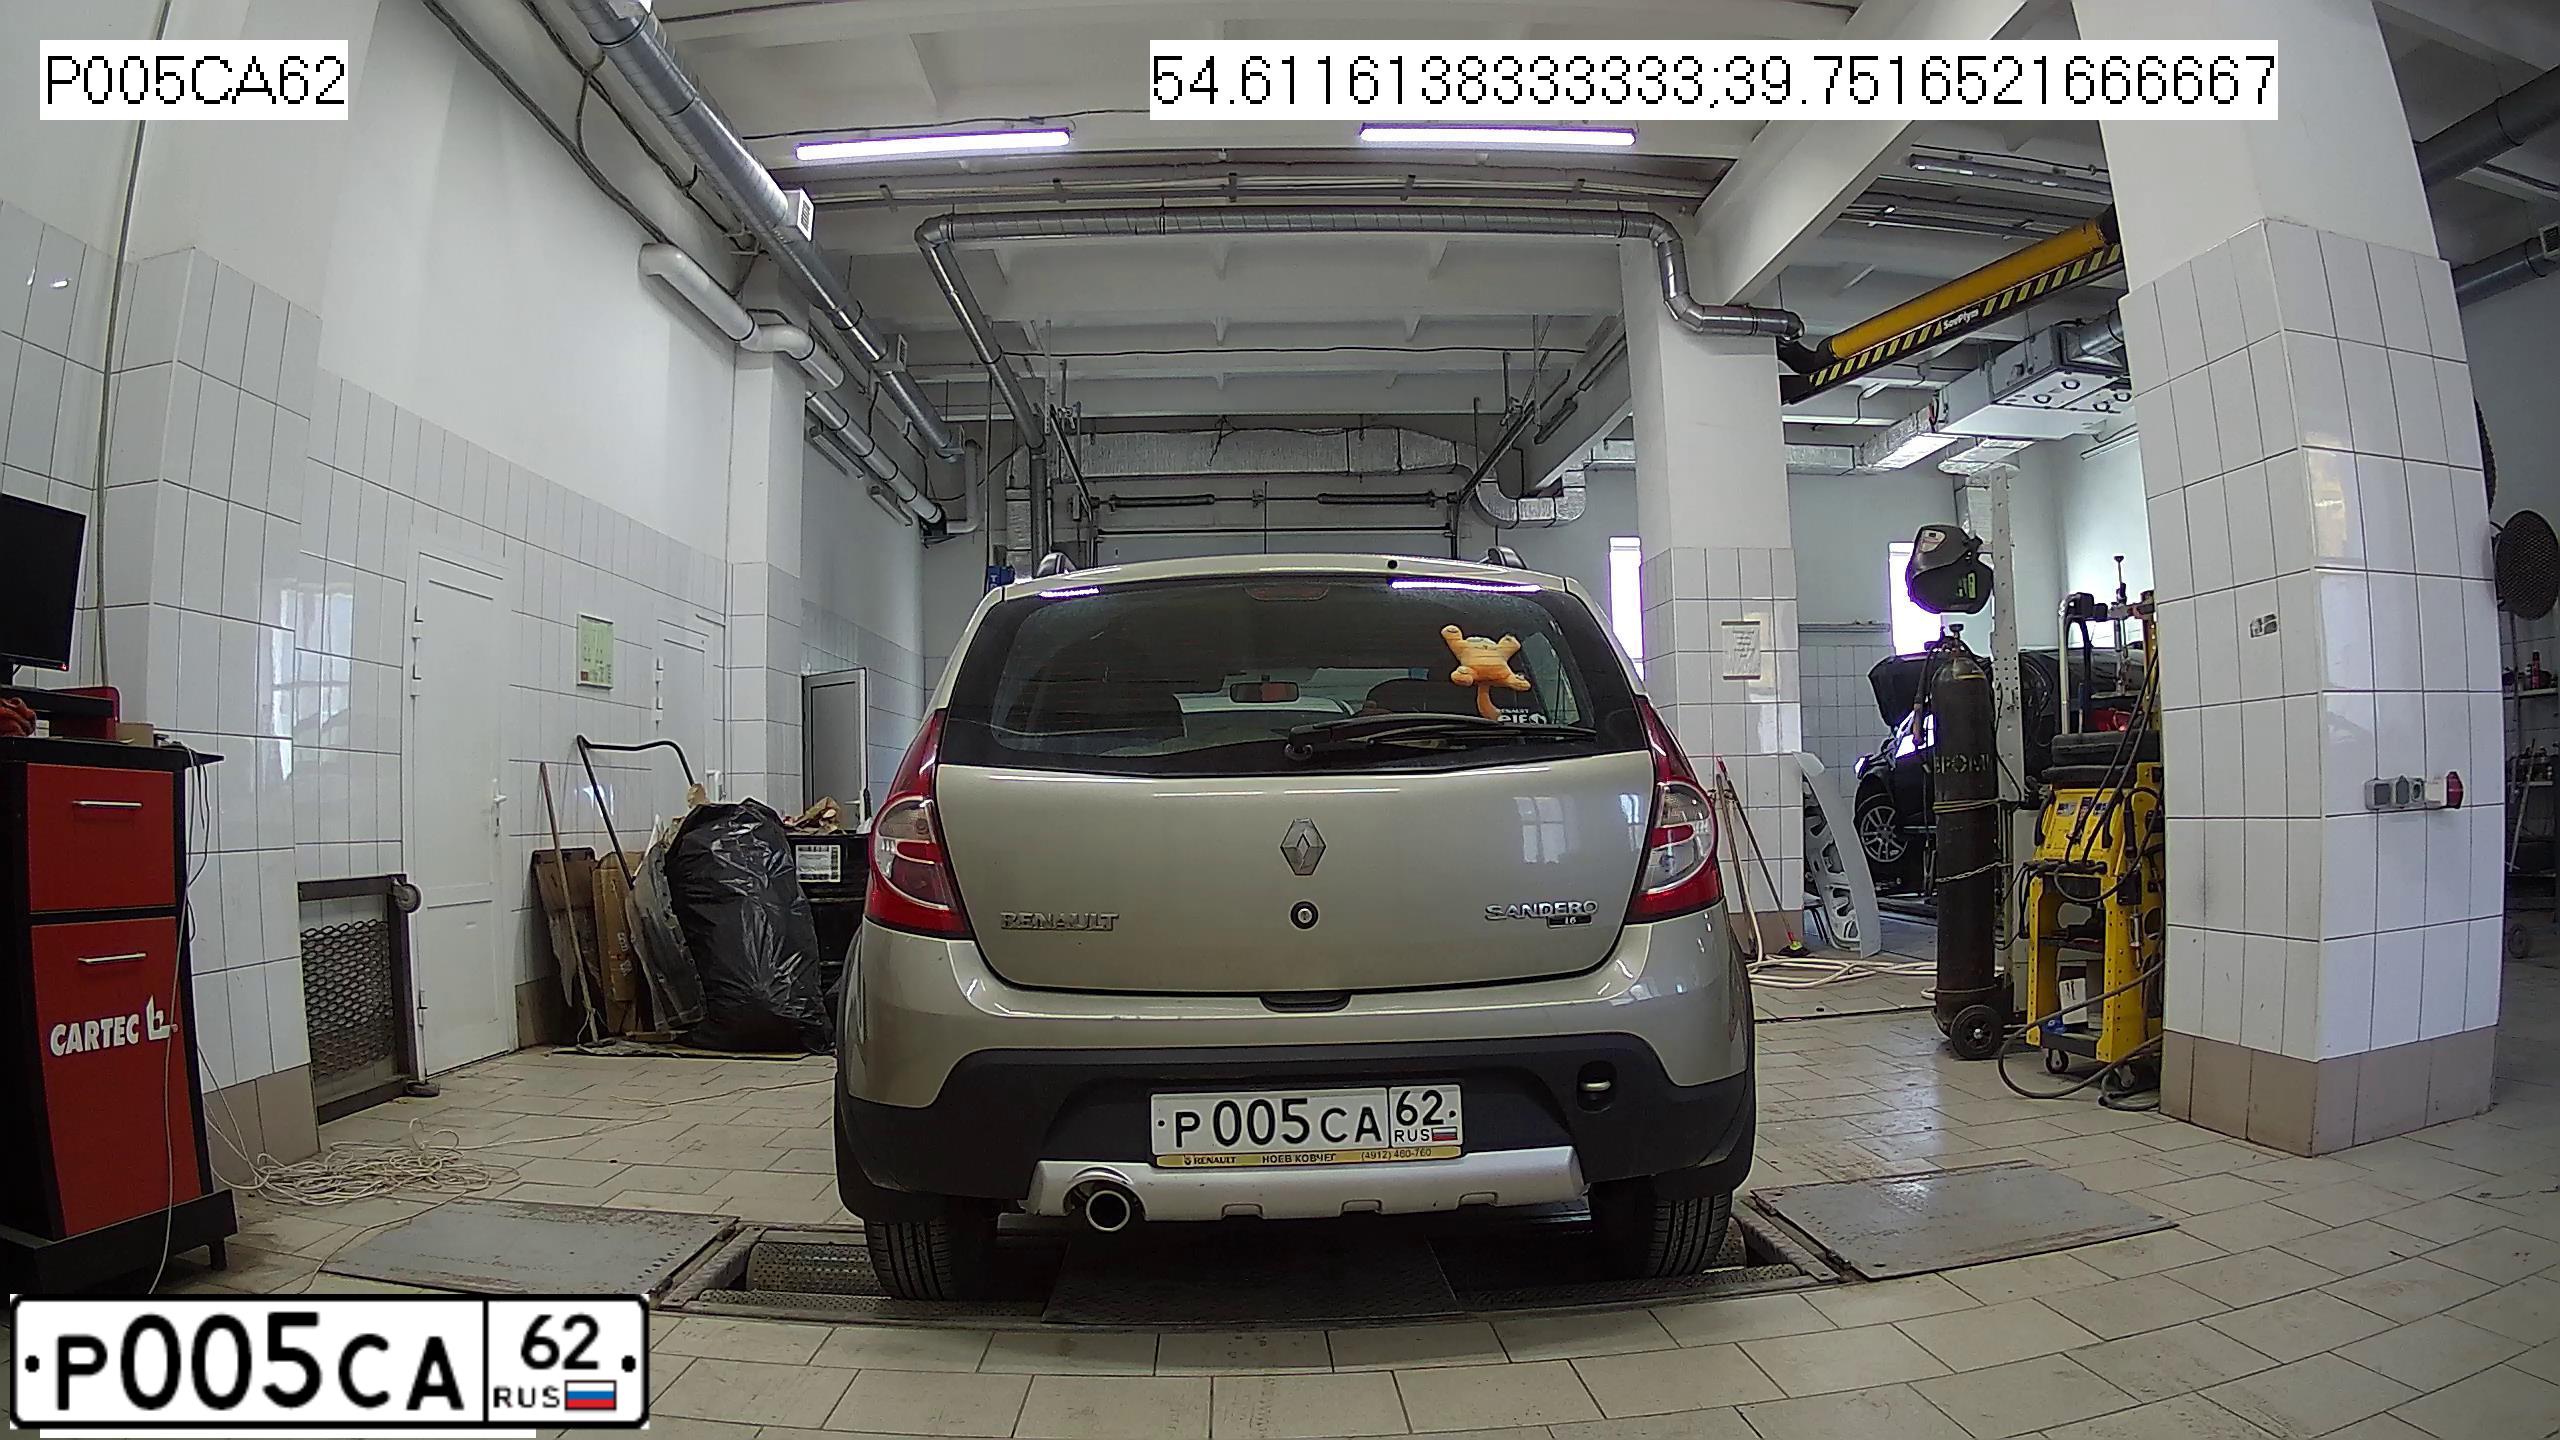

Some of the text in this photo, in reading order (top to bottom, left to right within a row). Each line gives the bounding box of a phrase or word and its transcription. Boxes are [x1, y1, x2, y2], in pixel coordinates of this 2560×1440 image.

[1484, 900, 1598, 920] SANDERO
[999, 911, 1119, 931] RENAULT
[50, 1013, 140, 1057] CARTEC
[1396, 1090, 1444, 1126] 62
[1394, 1129, 1430, 1143] RUS
[1193, 1156, 1236, 1165] RENAULT
[1262, 1153, 1336, 1163] НОЕВ КОВЧЕГ
[1361, 1151, 1392, 1161] (4912)
